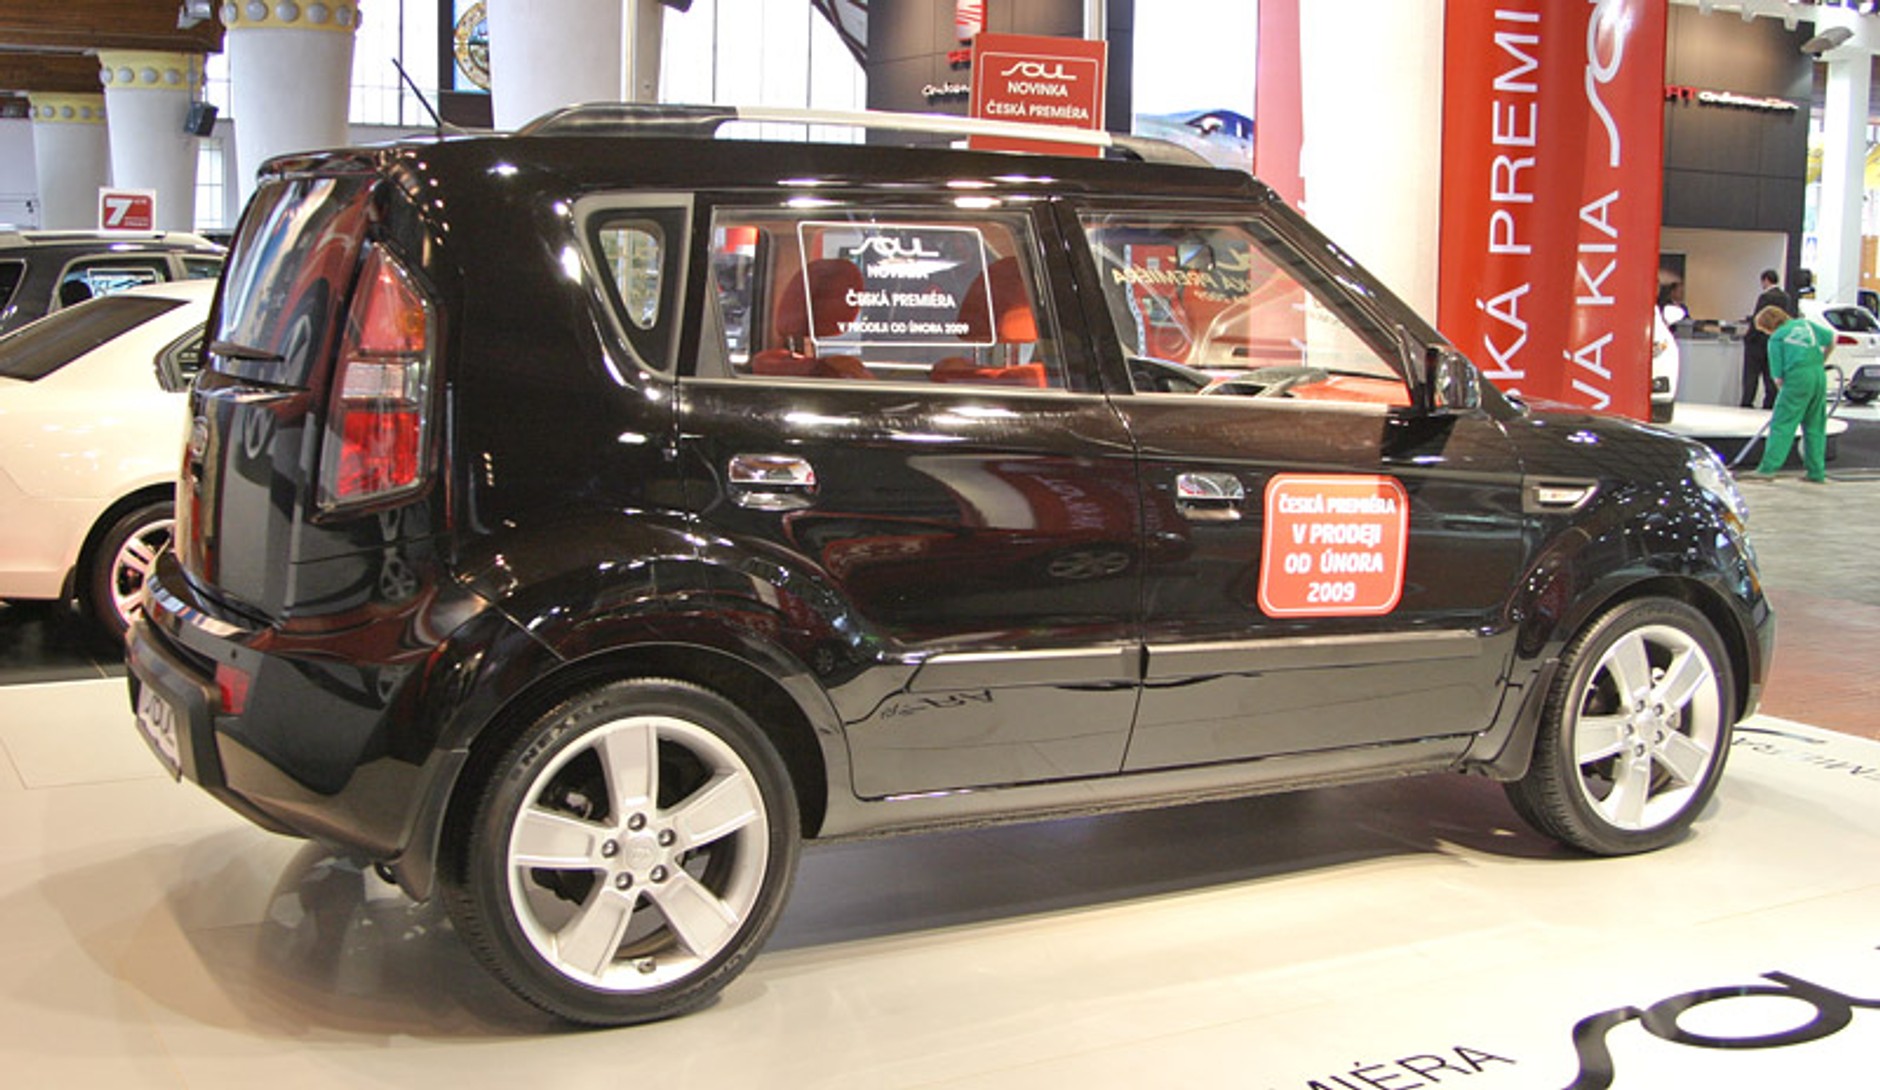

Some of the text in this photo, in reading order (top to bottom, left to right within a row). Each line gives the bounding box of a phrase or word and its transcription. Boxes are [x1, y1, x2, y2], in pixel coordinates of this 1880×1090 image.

[1001, 61, 1078, 81] SOUL
[1007, 81, 1069, 98] NOVINKA
[986, 99, 1089, 120] ČESKÁ PREMIÉRA
[105, 198, 133, 225] 7
[1575, 189, 1620, 305] KIA
[846, 288, 957, 308] ČESKÁ PREMIÉRA
[1279, 493, 1397, 515] ČESKÁ PREMIÉRA
[1292, 523, 1382, 548] V PRODEJI
[1284, 548, 1384, 574] OD ÚNORA
[1306, 581, 1356, 603] 2009
